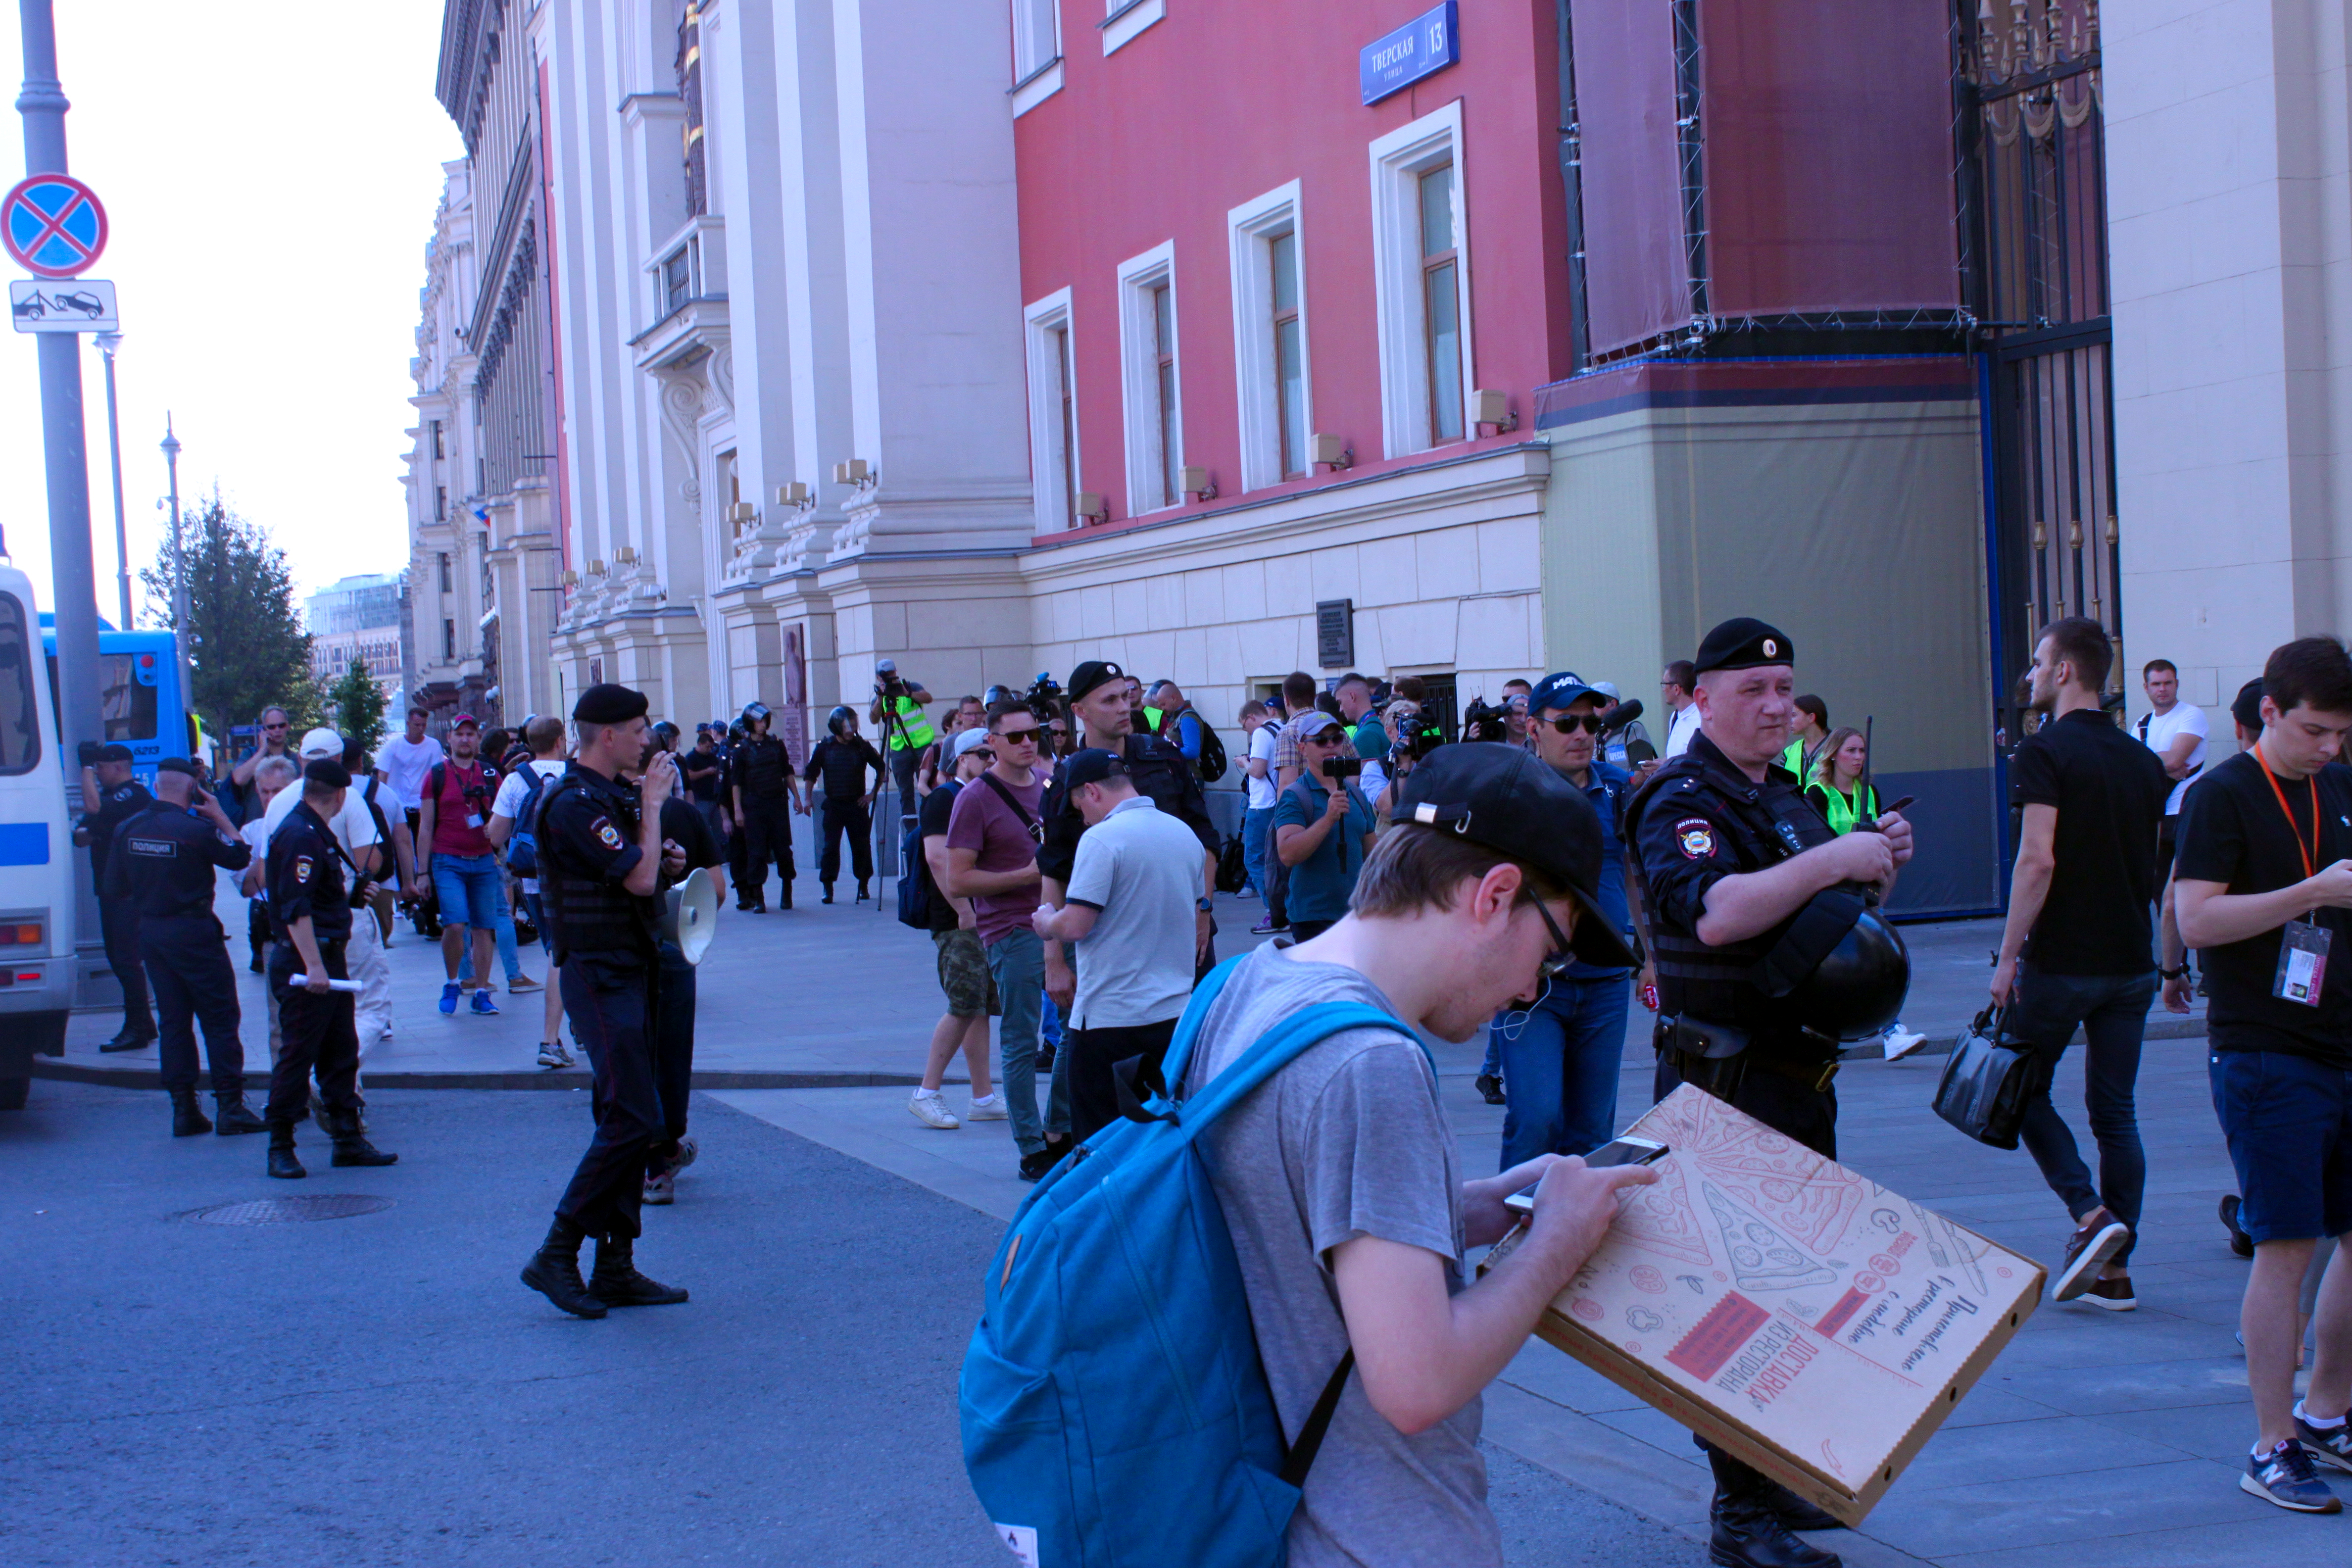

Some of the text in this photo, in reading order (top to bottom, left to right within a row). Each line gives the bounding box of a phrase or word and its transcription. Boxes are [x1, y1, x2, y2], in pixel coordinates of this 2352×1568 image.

[1372, 35, 1414, 73] ТВЕРСКАЯ
[1429, 22, 1442, 54] 13
[1384, 66, 1403, 82] УЛИЦА
[134, 746, 159, 755] 6213
[1677, 819, 1708, 829] ПОЛИЦИЯ
[132, 841, 170, 853] ПОЛИЦИЯ
[1937, 1275, 1955, 1287] в
[1848, 1300, 1889, 1344] любовью
[1892, 1279, 1941, 1335] ресторане
[1902, 1295, 1979, 1372] Приготовлено
[1715, 1320, 1794, 1393] ИЗ РЕСТОРАНА
[1744, 1333, 1819, 1403] ДОСТАВКА
